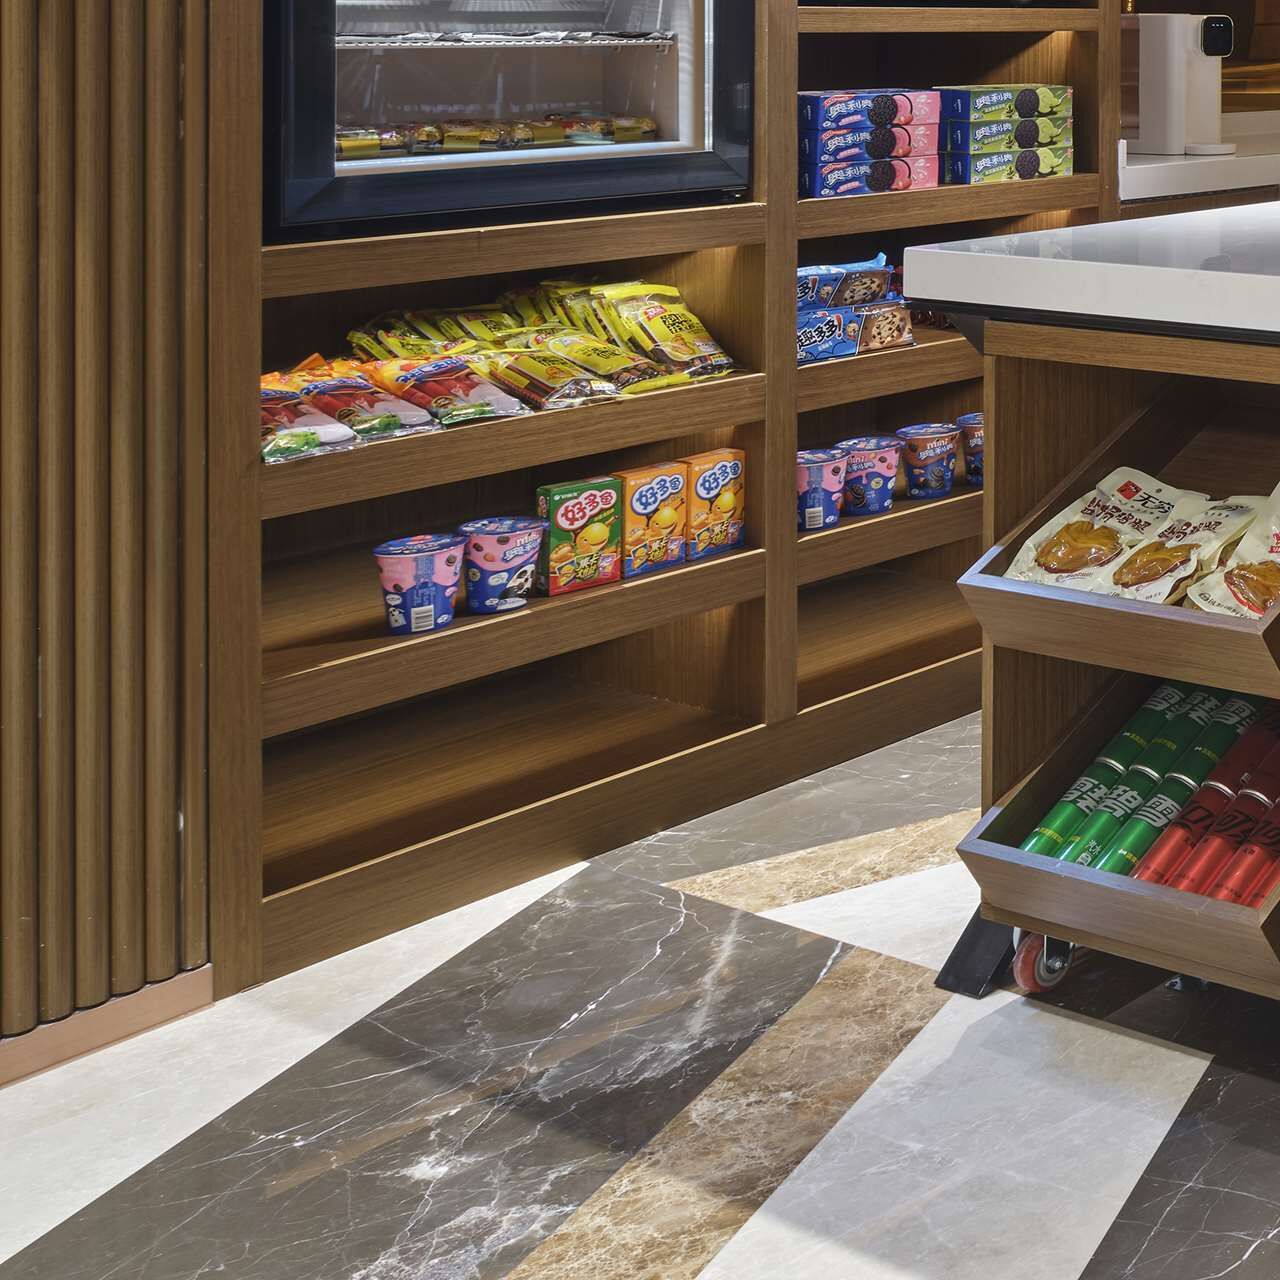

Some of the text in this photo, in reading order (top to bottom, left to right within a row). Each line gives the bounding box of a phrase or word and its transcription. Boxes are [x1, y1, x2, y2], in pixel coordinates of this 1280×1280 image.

[927, 438, 949, 450] mini
[635, 476, 682, 511] 好多鱼
[699, 462, 741, 496] 好多鱼
[560, 491, 613, 526] 好多鱼
[1133, 491, 1175, 514] 无穷
